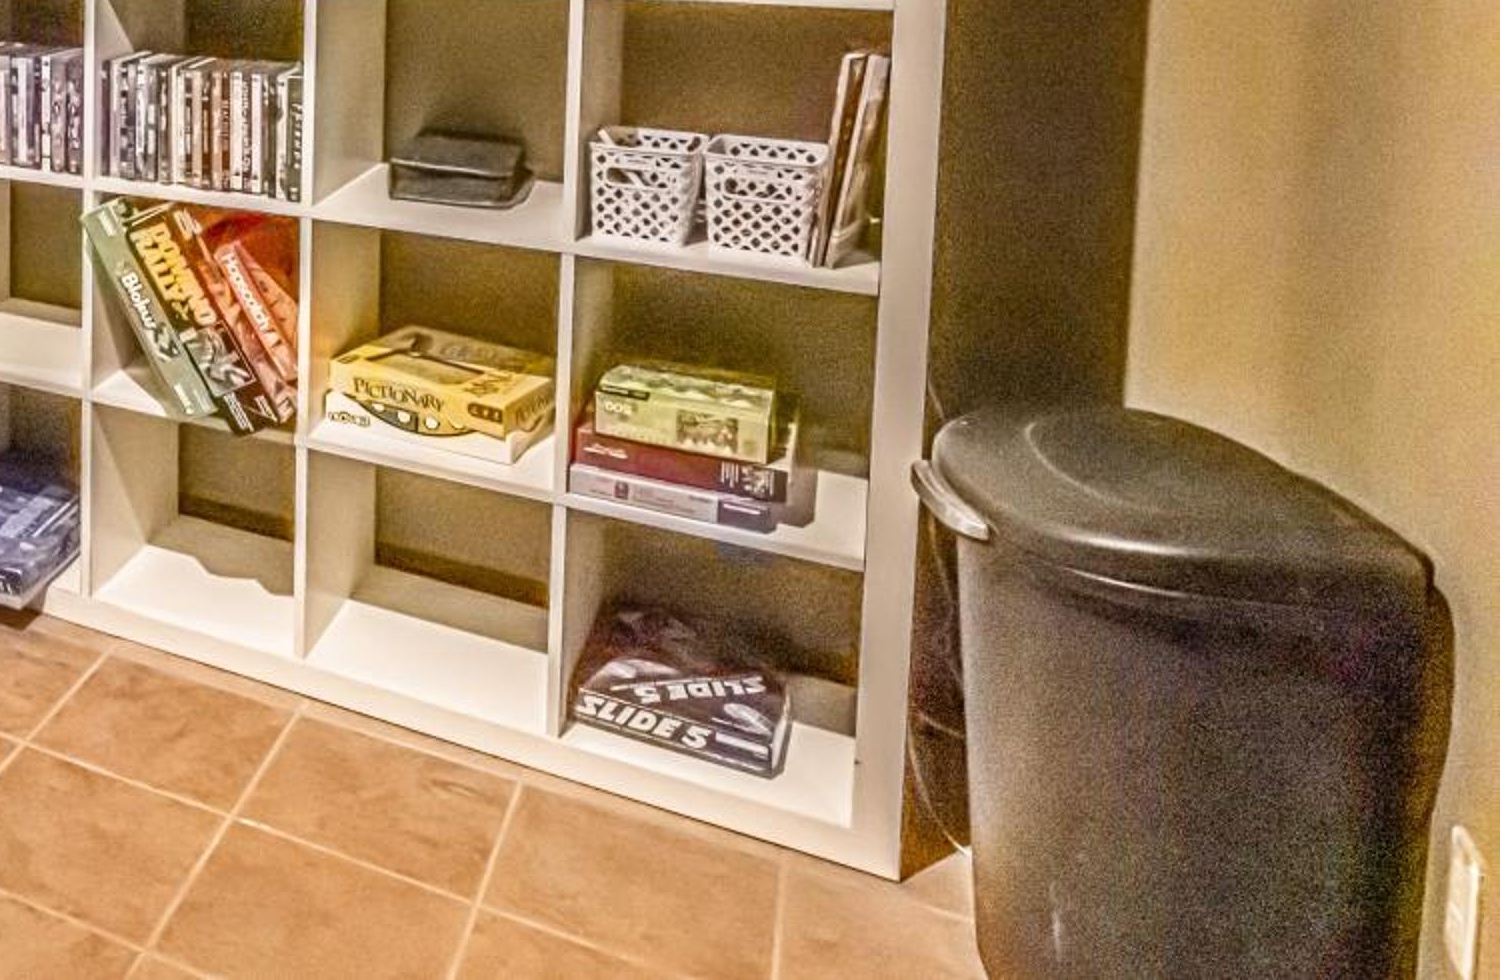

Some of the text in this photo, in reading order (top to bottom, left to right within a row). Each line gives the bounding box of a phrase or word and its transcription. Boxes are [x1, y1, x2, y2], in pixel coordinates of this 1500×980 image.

[120, 270, 157, 330] Blokus
[635, 675, 766, 705] SLIDE 5
[576, 695, 712, 749] SLIDE 5
